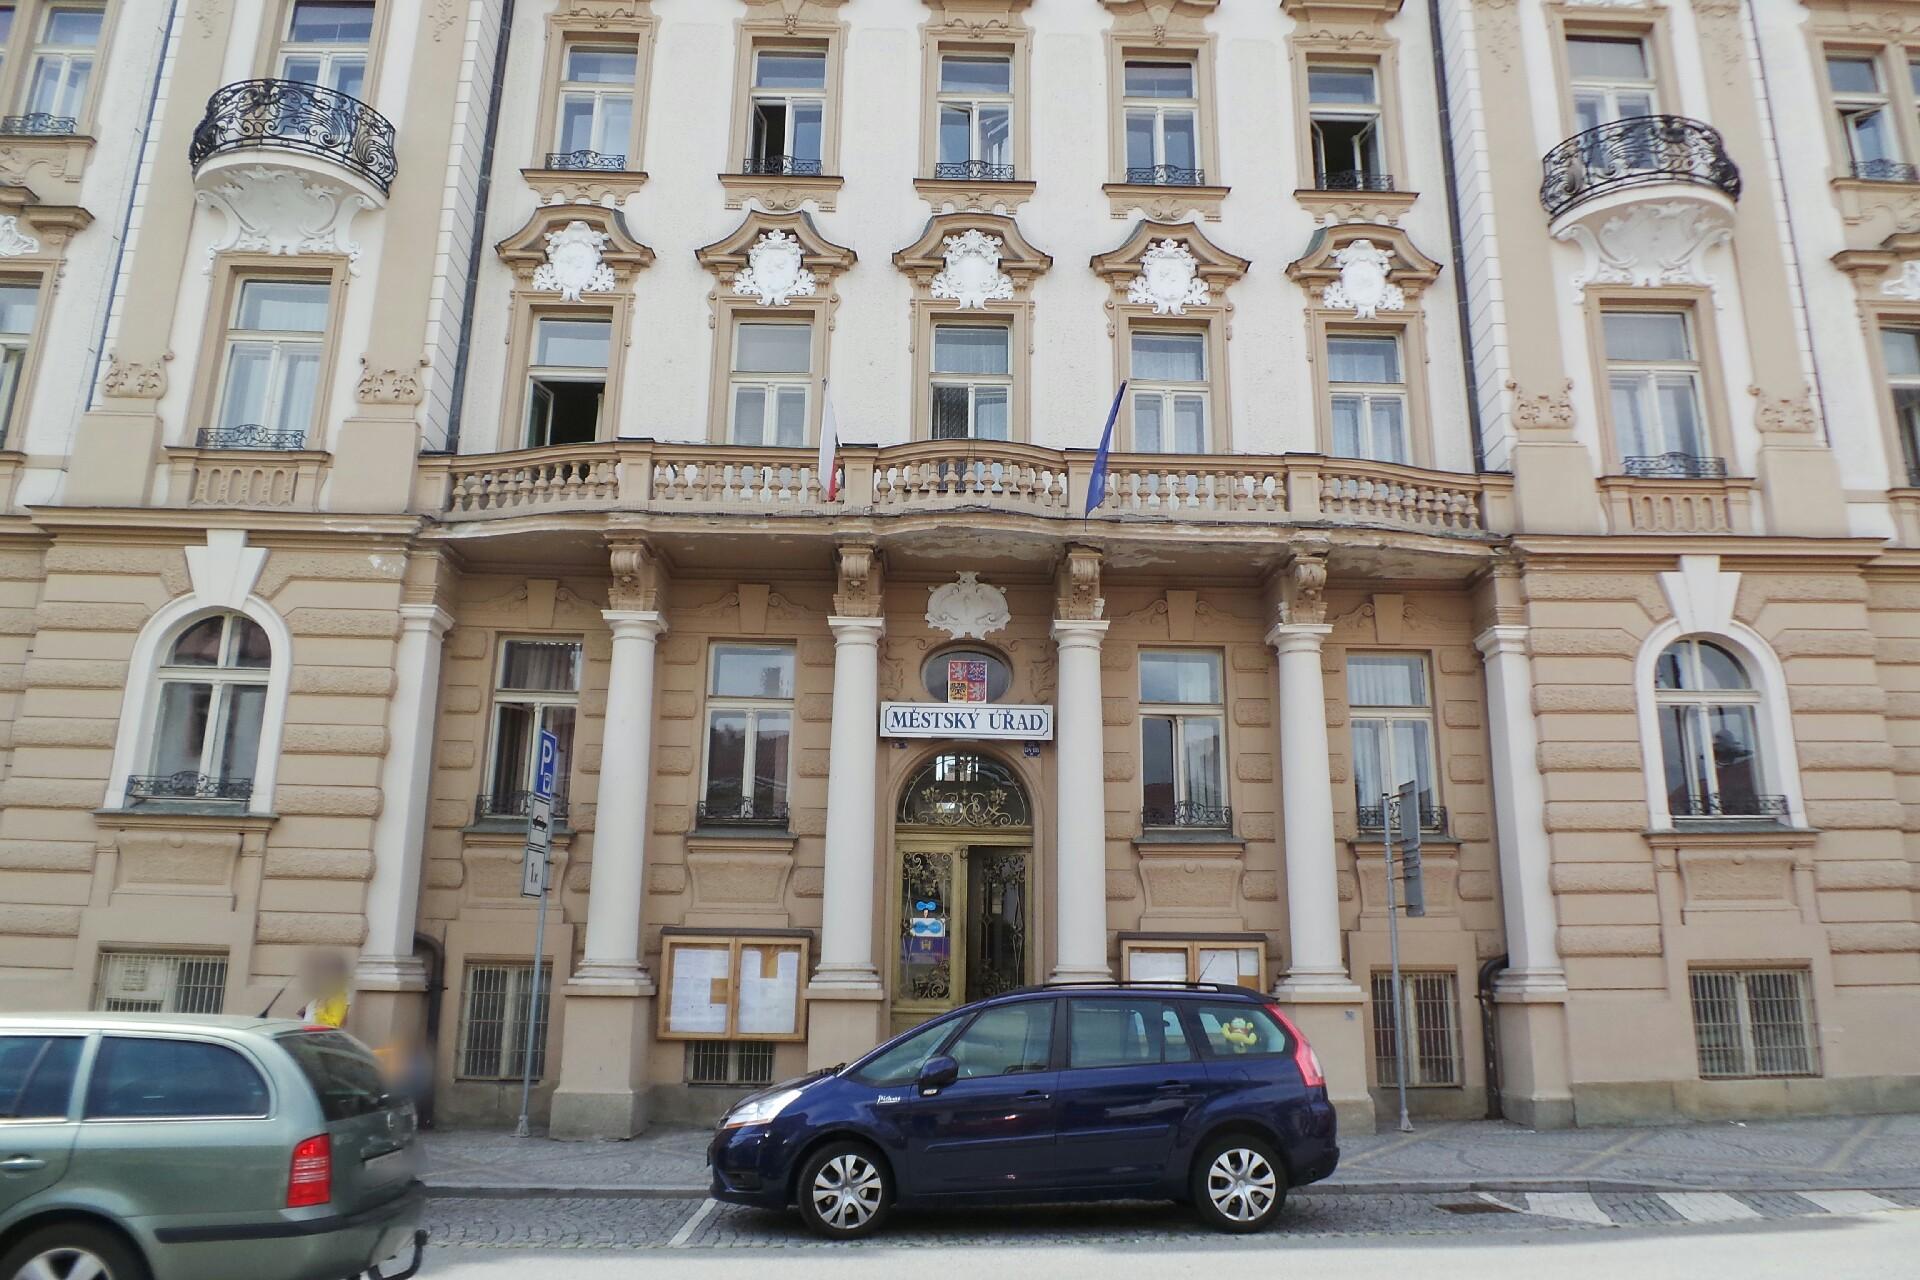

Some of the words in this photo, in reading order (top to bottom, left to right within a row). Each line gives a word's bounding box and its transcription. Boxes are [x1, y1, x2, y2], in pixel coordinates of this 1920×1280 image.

[890, 706, 980, 729] MĚSTSKÝ
[988, 709, 1044, 731] ÚŘAD
[540, 739, 552, 776] P
